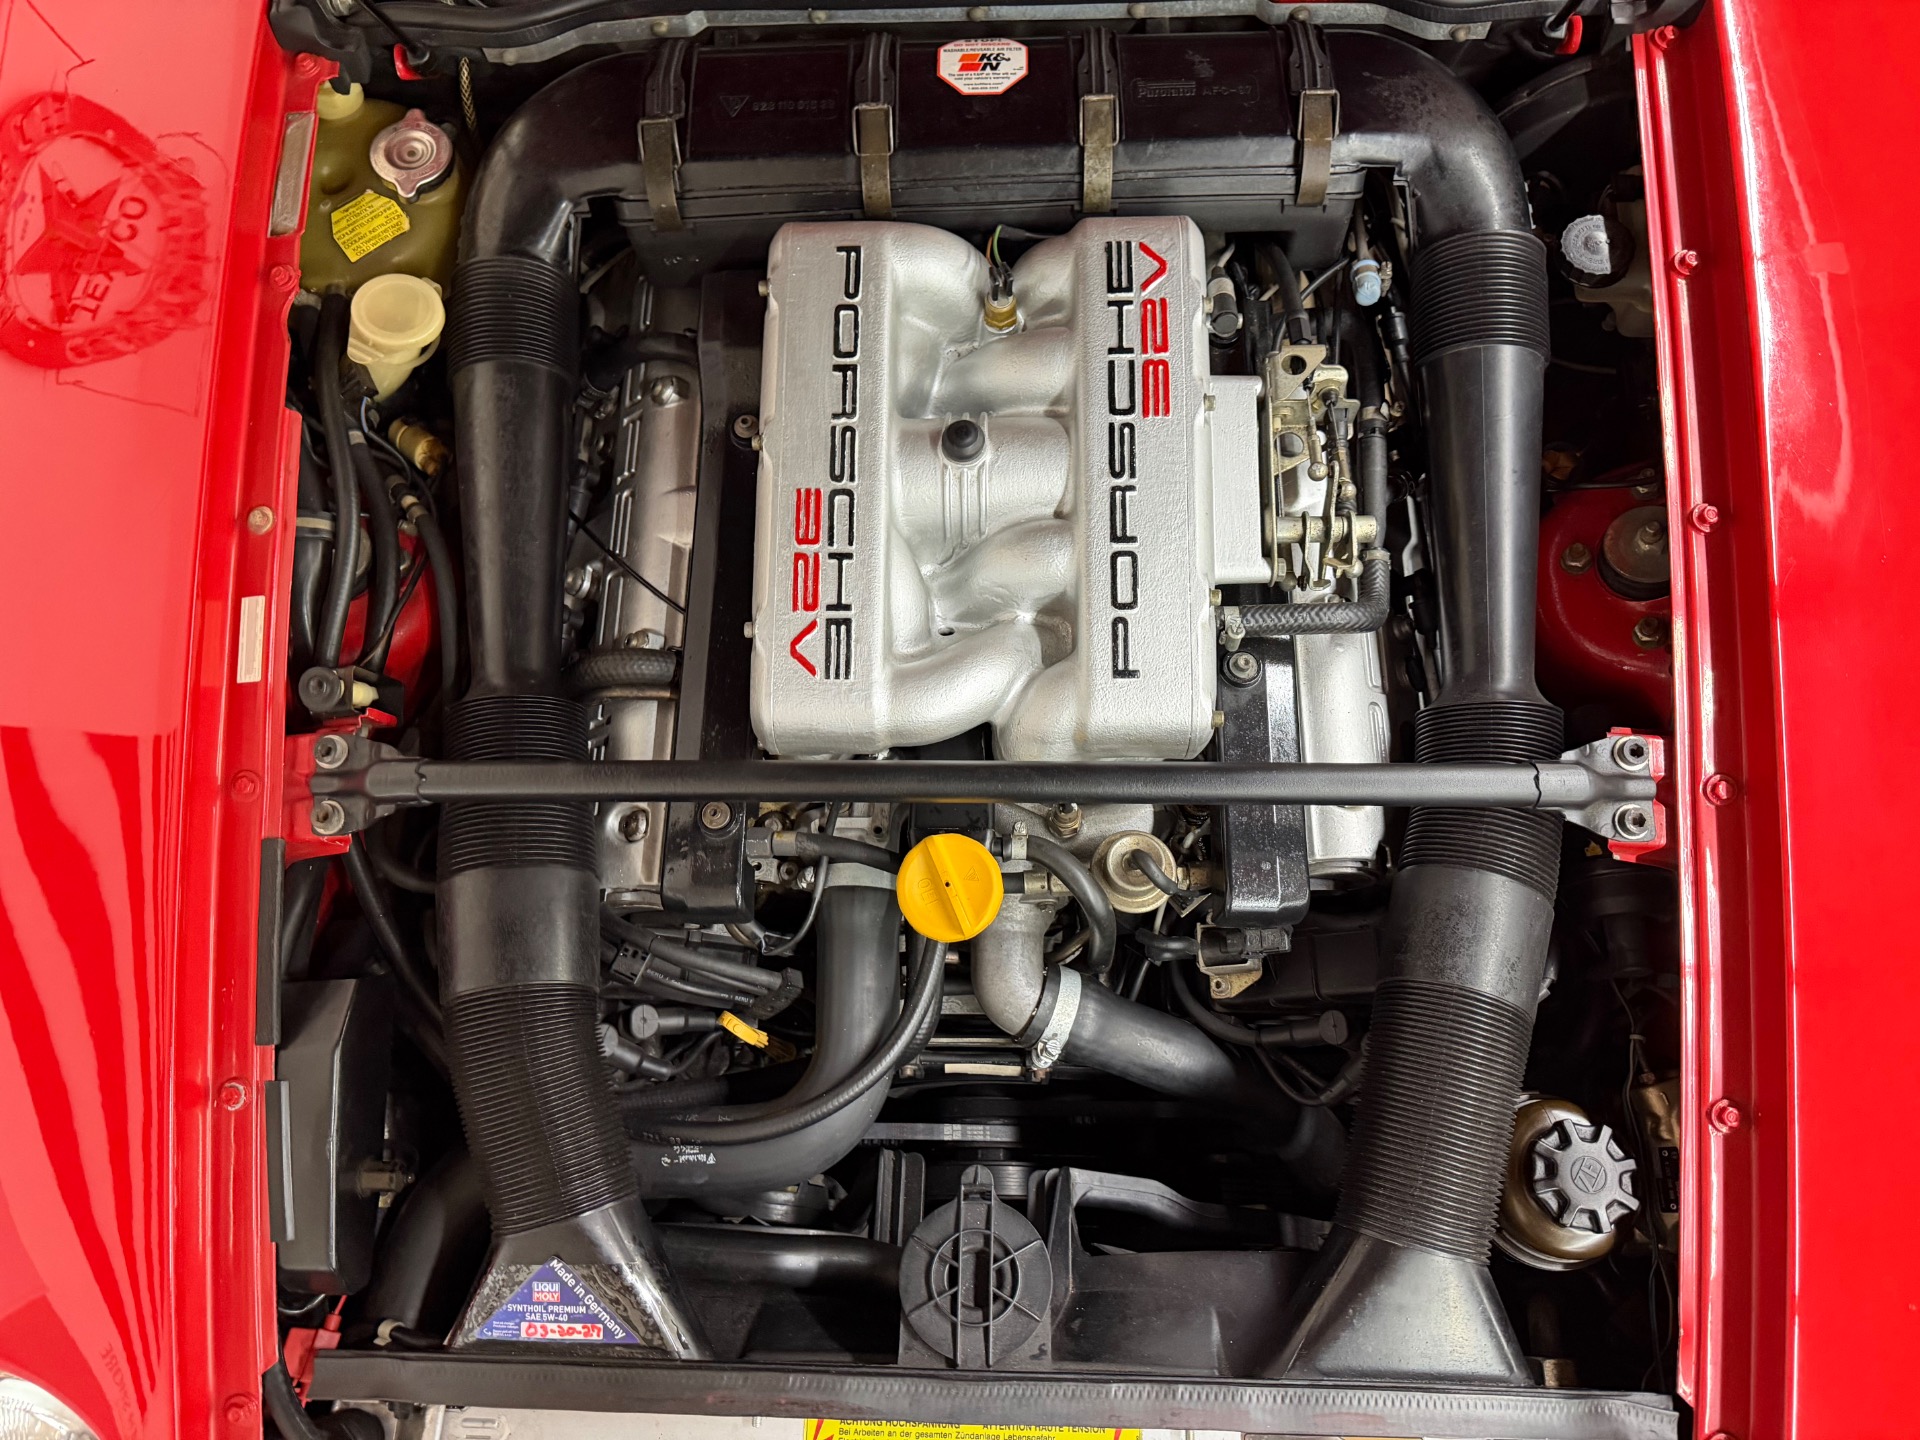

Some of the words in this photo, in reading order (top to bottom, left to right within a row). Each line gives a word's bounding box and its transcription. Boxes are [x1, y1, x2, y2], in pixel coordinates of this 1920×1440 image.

[978, 52, 1011, 62] K&
[980, 62, 1001, 71] N
[1139, 241, 1170, 418] 32V
[824, 245, 862, 680] PORSCHE
[1105, 240, 1140, 679] PORSCHE
[790, 488, 822, 678] 32V
[534, 1282, 559, 1292] LIQUI
[534, 1292, 559, 1301] MOLY
[550, 1258, 576, 1288] Made
[574, 1284, 586, 1298] in
[584, 1294, 626, 1339] Germany
[507, 1304, 546, 1313] SYNTHOIL
[548, 1305, 586, 1314] PREMIUM
[915, 1431, 952, 1439] gesamten
[955, 1430, 1000, 1440] Zündanlage
